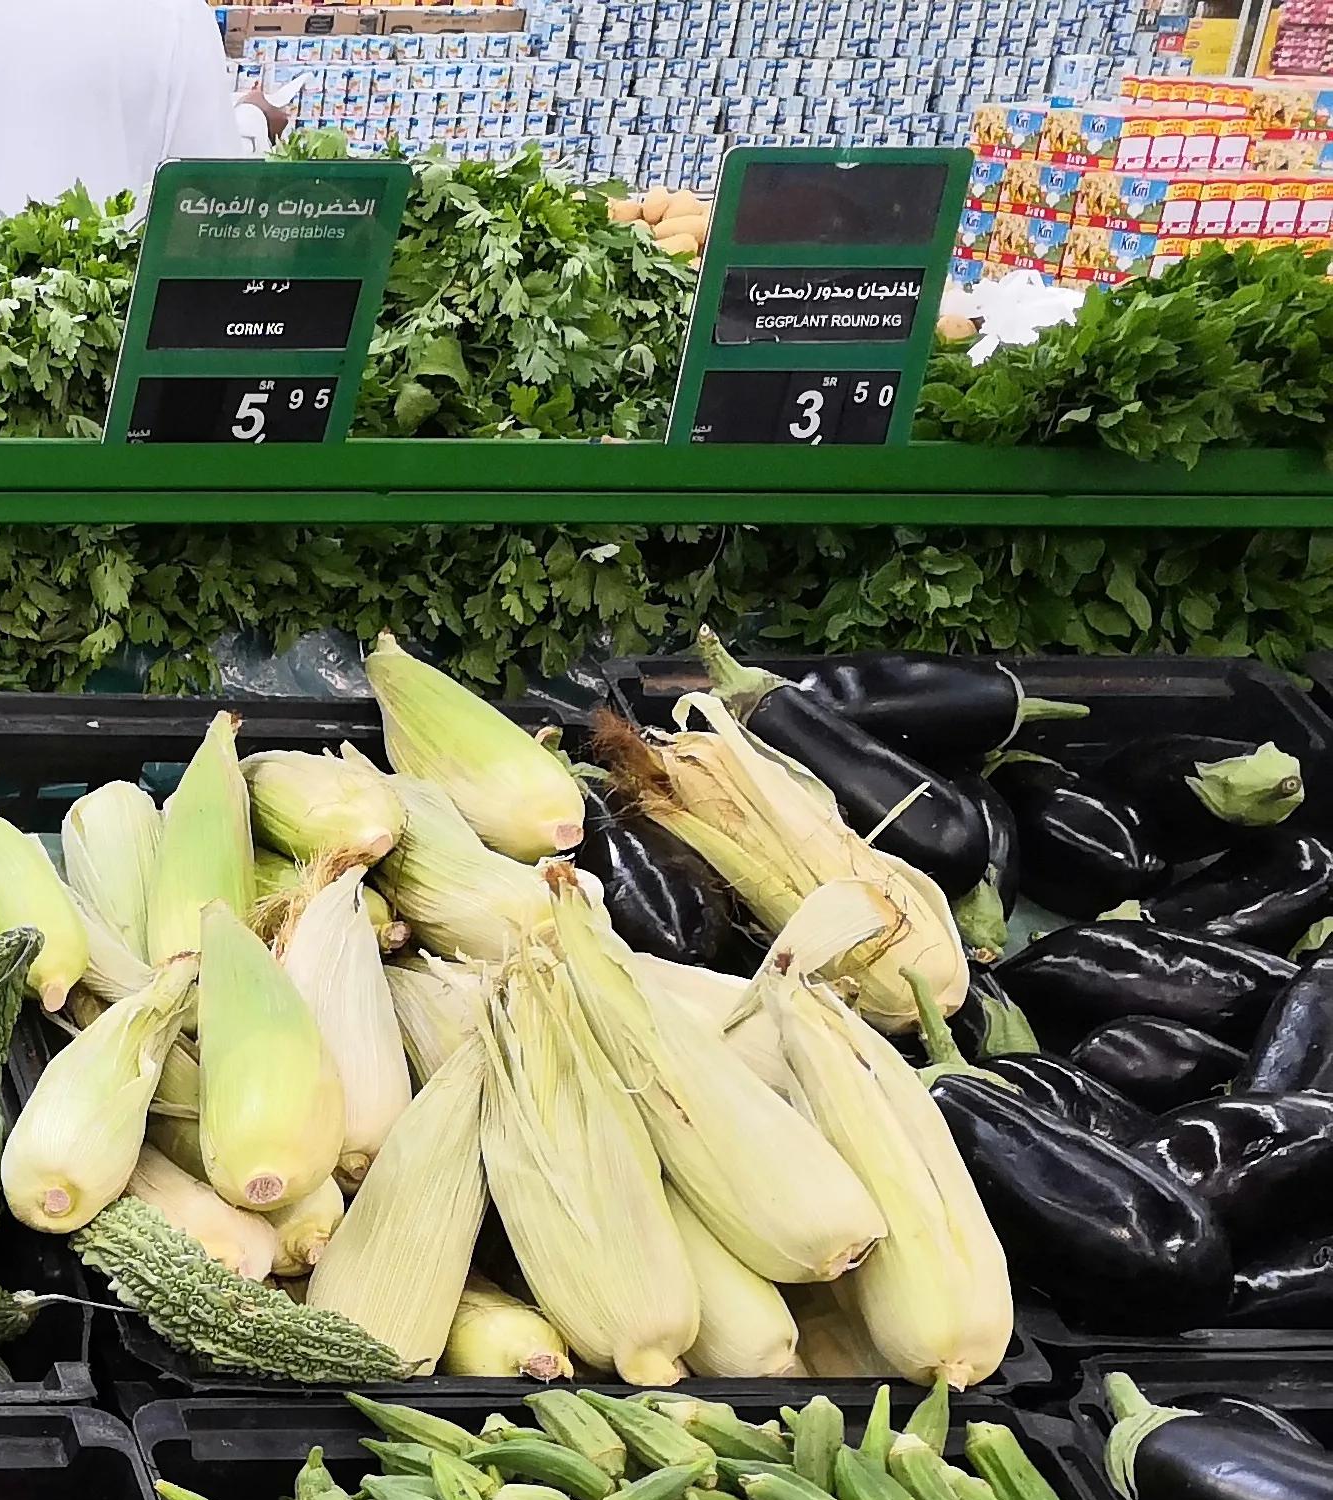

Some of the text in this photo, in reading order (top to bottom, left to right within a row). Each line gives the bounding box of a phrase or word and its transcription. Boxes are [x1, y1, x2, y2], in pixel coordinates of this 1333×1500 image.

[180, 196, 253, 219] الفواكه
[277, 198, 375, 218] الخضروات
[198, 223, 345, 241] Fruits & Vegetables
[813, 286, 854, 301] مدور
[857, 282, 921, 303] باذنجان
[226, 322, 284, 336] CORN KG
[755, 314, 902, 329] EGGPLANT ROUND KG
[259, 380, 275, 391] SR
[822, 376, 838, 387] SR
